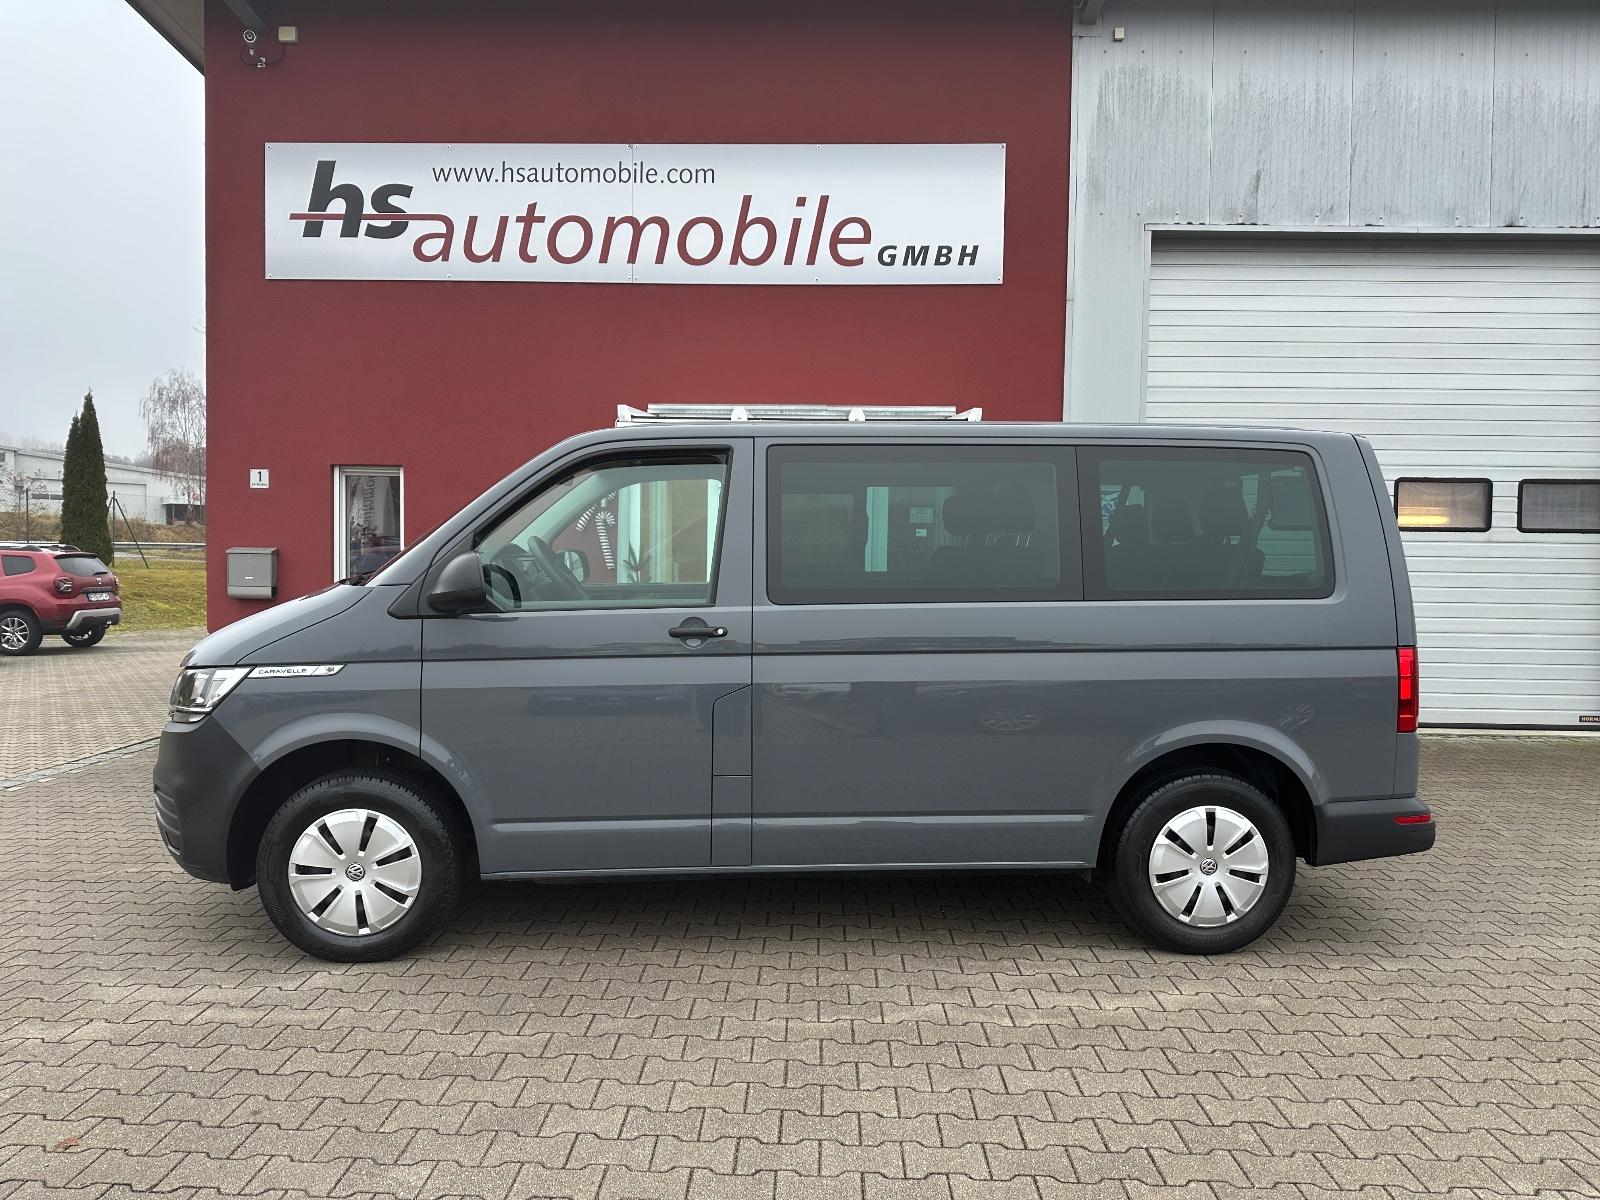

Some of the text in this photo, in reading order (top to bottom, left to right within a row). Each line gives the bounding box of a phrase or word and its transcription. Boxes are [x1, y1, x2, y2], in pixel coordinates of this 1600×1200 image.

[432, 160, 715, 184] www.hsautomobile.com
[302, 160, 979, 267] hs automobile GMBH
[257, 470, 262, 482] 1
